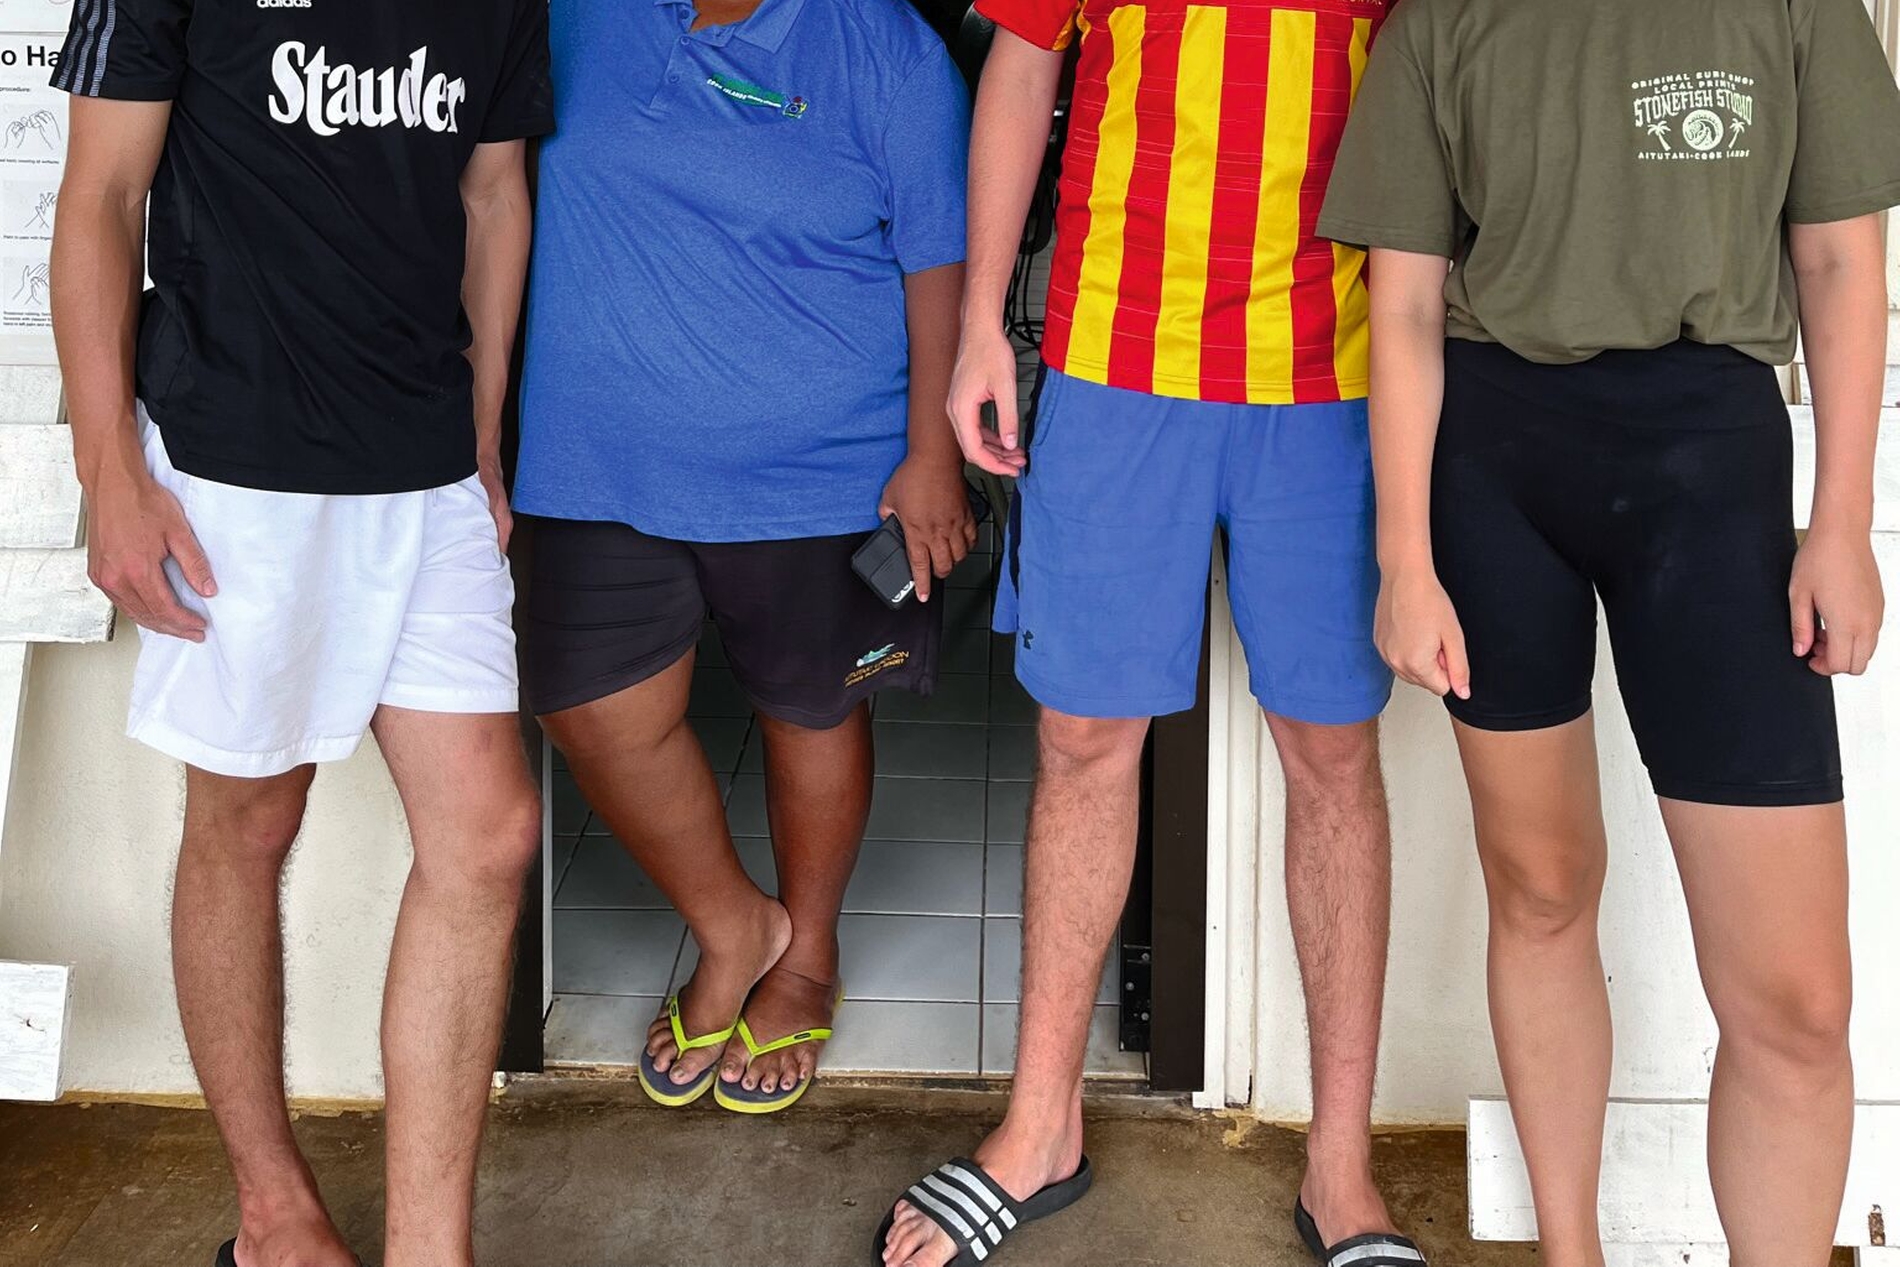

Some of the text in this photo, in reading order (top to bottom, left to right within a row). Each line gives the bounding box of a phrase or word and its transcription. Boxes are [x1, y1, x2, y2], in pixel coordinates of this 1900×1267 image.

[268, 40, 466, 136] Stauder
[1631, 73, 1691, 90] ORIGINAL
[1654, 81, 1694, 95] LOCAL
[1633, 89, 1713, 128] STONEFISH
